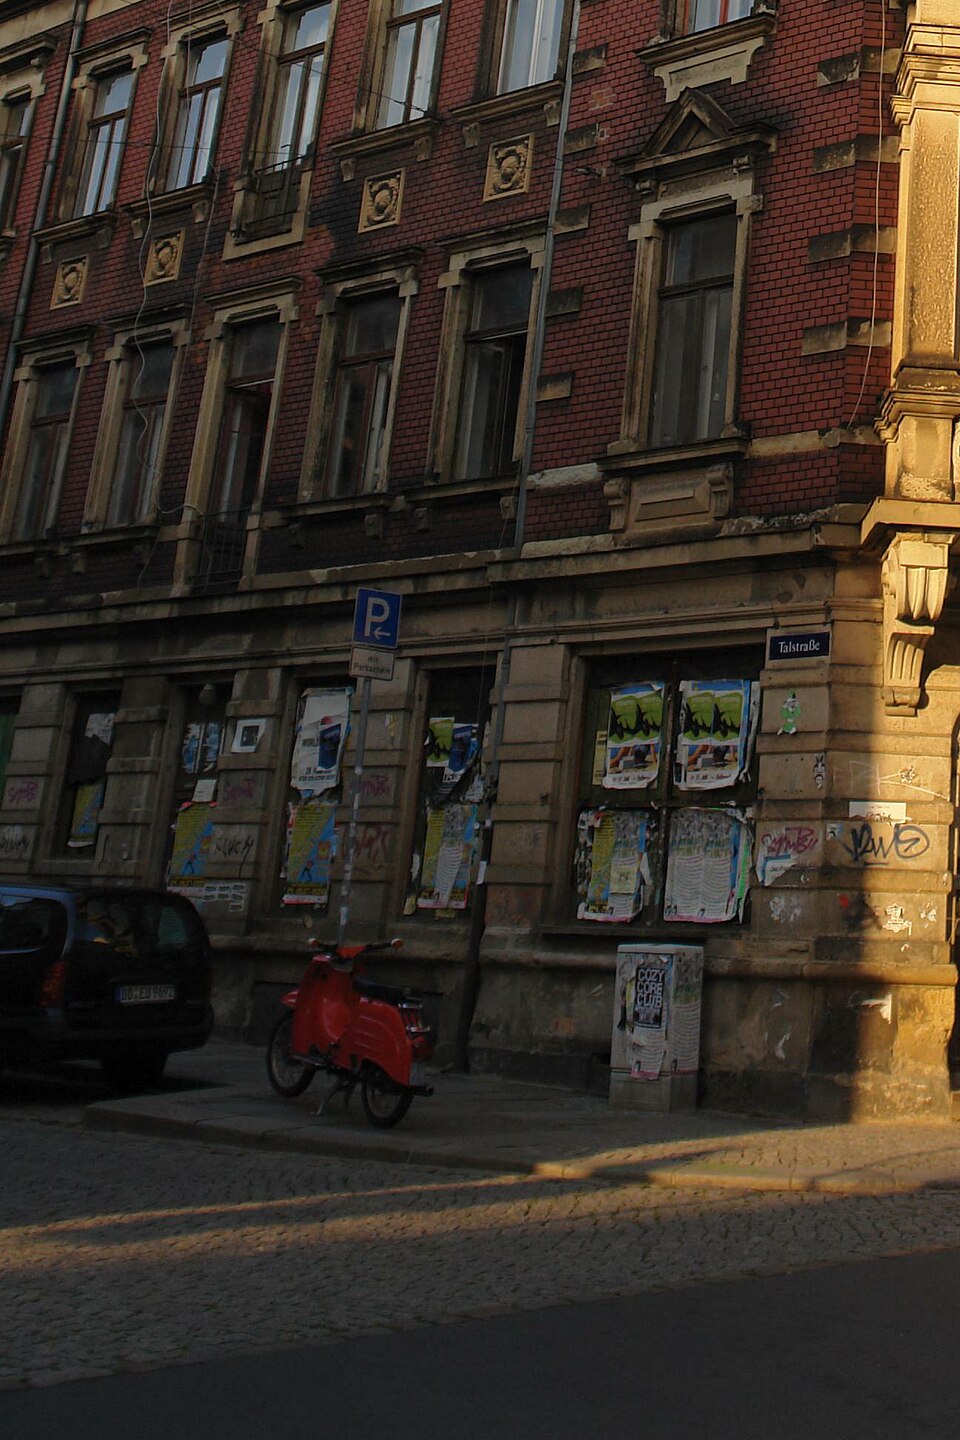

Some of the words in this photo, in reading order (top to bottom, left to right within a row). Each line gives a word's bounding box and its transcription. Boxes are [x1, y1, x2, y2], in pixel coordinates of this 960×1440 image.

[364, 596, 390, 637] P
[778, 639, 820, 653] Talstraße
[638, 968, 664, 982] COZY
[637, 981, 663, 995] CORE
[637, 994, 663, 1009] CLUB
